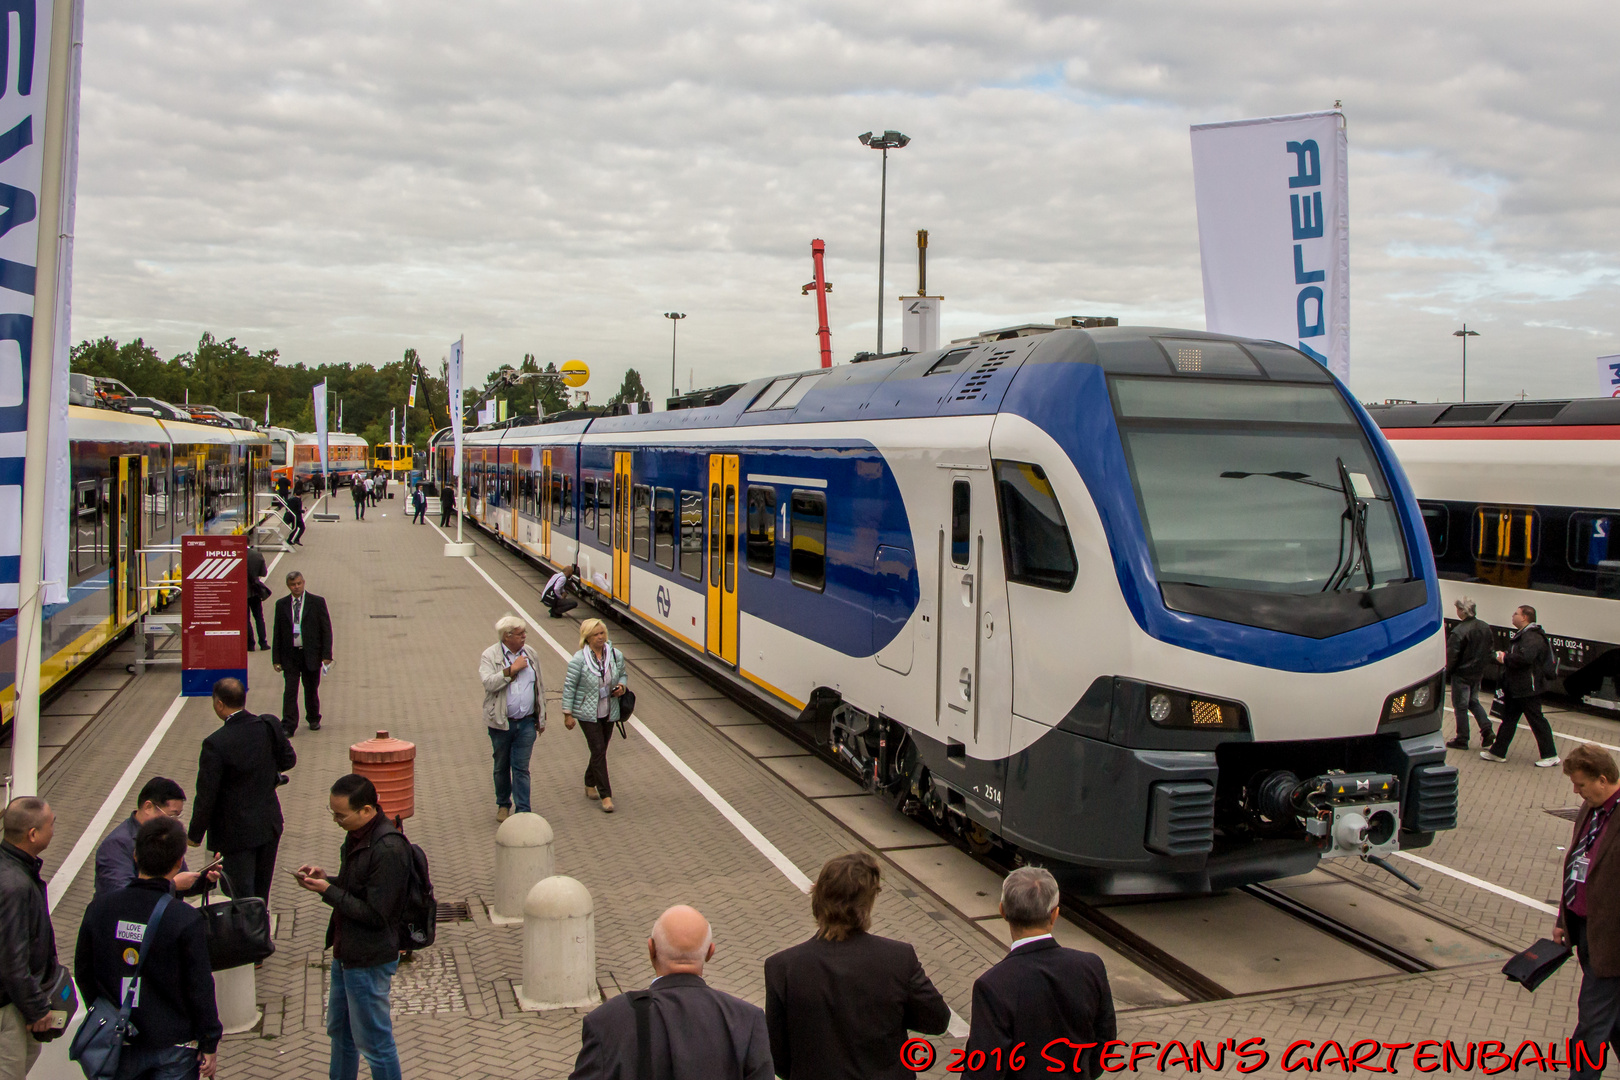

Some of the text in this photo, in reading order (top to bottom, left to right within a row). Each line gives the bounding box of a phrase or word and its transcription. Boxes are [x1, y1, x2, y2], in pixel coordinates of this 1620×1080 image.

[780, 502, 786, 539] 1
[1553, 638, 1564, 647] 501
[1565, 640, 1583, 649] 002-4
[985, 784, 1001, 805] 2514
[126, 923, 141, 932] LOVE
[118, 931, 143, 940] YOURSEL
